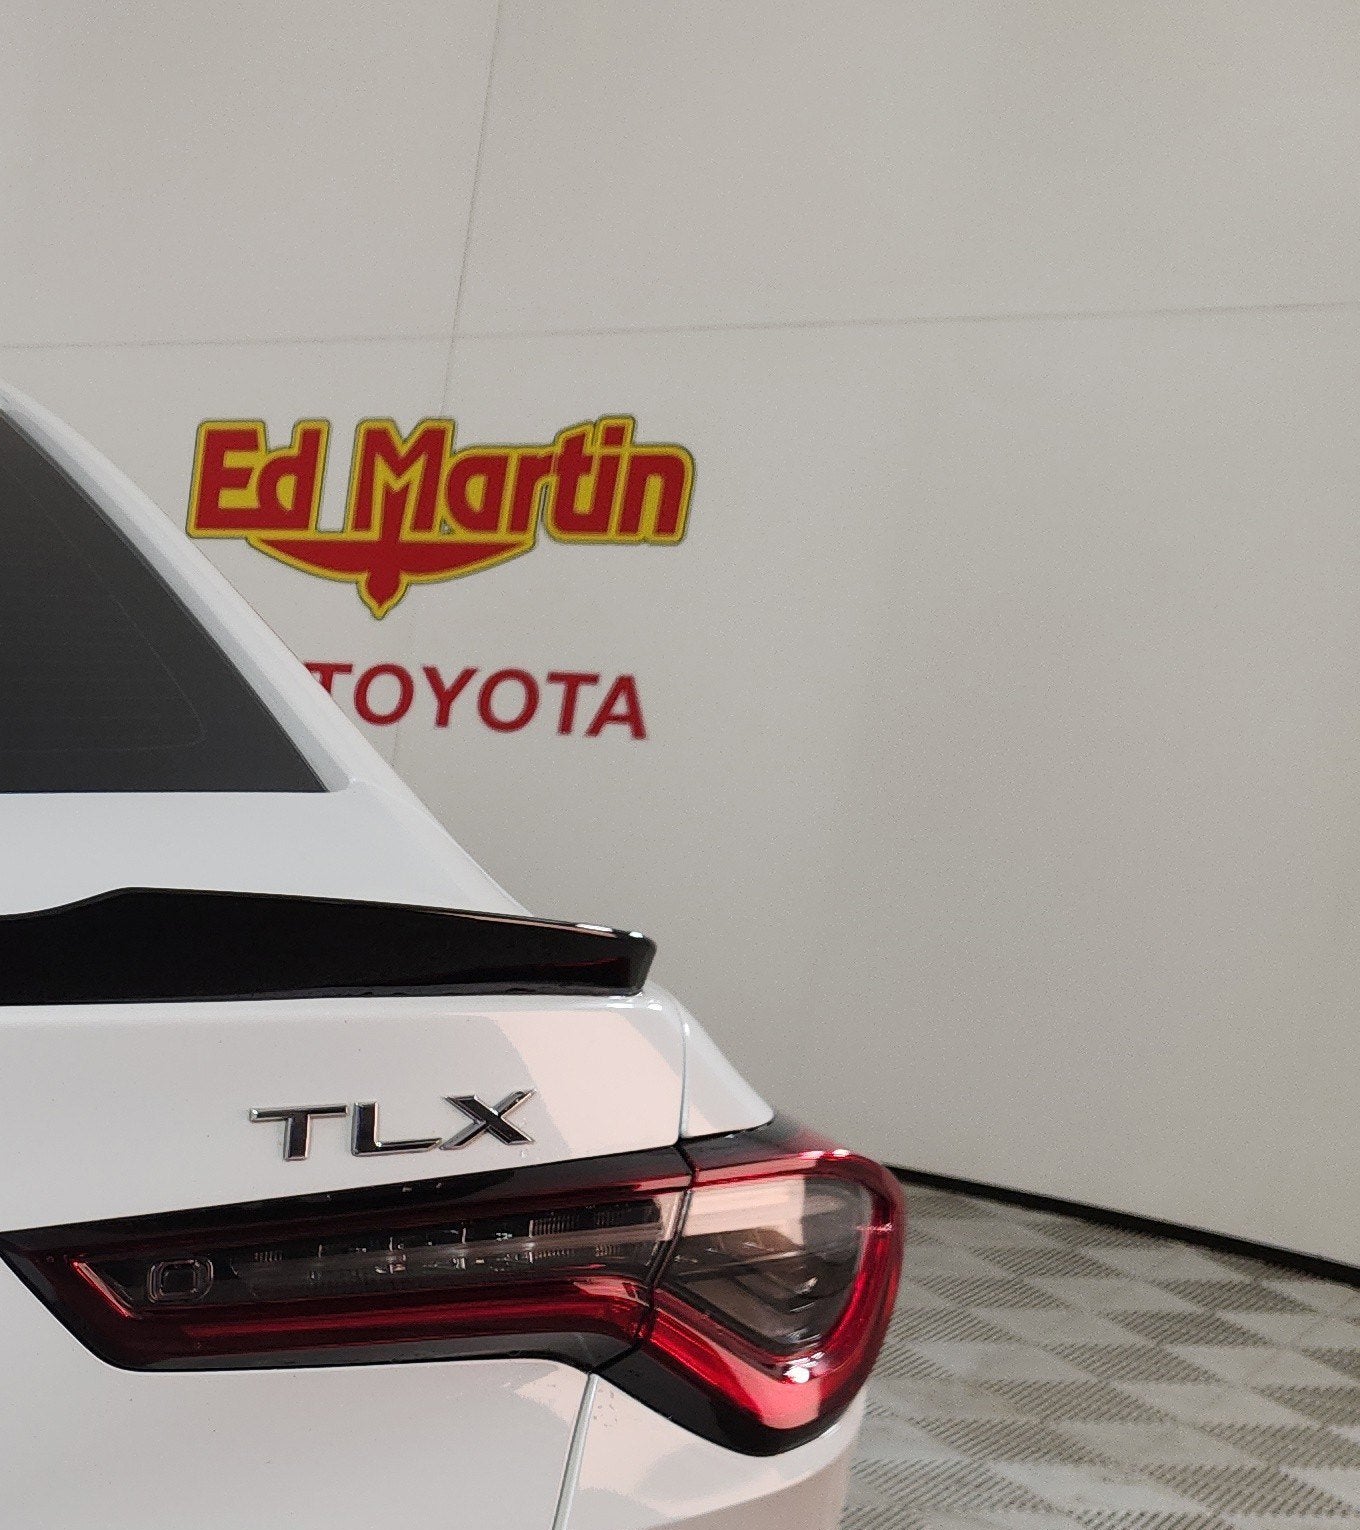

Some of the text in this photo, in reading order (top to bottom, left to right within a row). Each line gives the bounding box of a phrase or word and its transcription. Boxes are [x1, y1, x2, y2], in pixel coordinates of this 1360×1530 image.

[186, 415, 696, 546] Ed Martin
[249, 1088, 537, 1162] TLX
